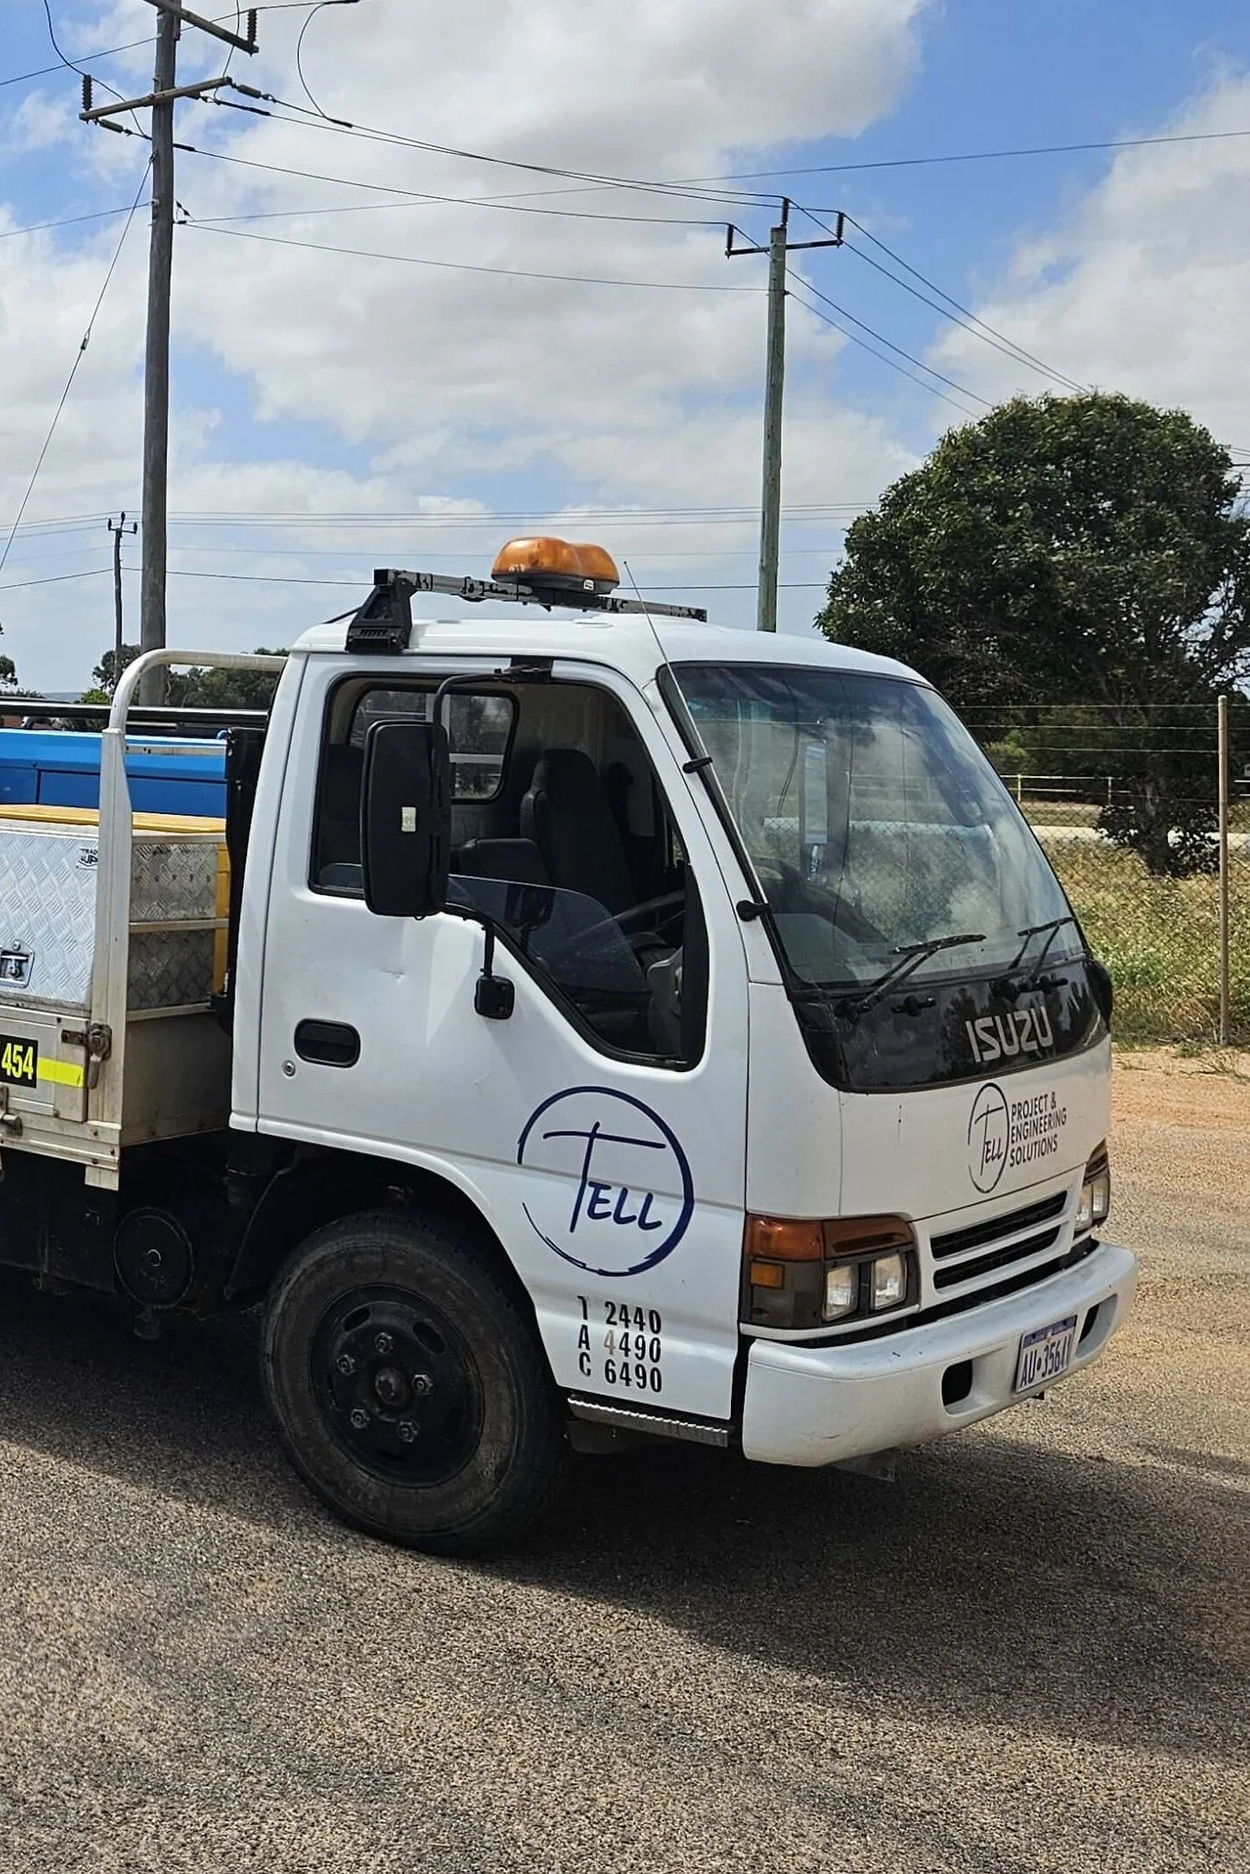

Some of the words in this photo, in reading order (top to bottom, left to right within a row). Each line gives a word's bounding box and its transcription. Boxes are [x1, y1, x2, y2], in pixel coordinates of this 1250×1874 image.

[965, 1005, 1054, 1063] ISUZU
[1, 1042, 34, 1080] 454
[1011, 1093, 1048, 1122] PROJECT
[1051, 1091, 1057, 1110] &
[1011, 1107, 1067, 1144] ENGINEERING
[1010, 1133, 1058, 1168] SOLUTIONS
[604, 1301, 662, 1335] 2440
[578, 1324, 591, 1351] A
[604, 1329, 661, 1363] 4490
[579, 1352, 591, 1377] C
[605, 1358, 662, 1393] 6490
